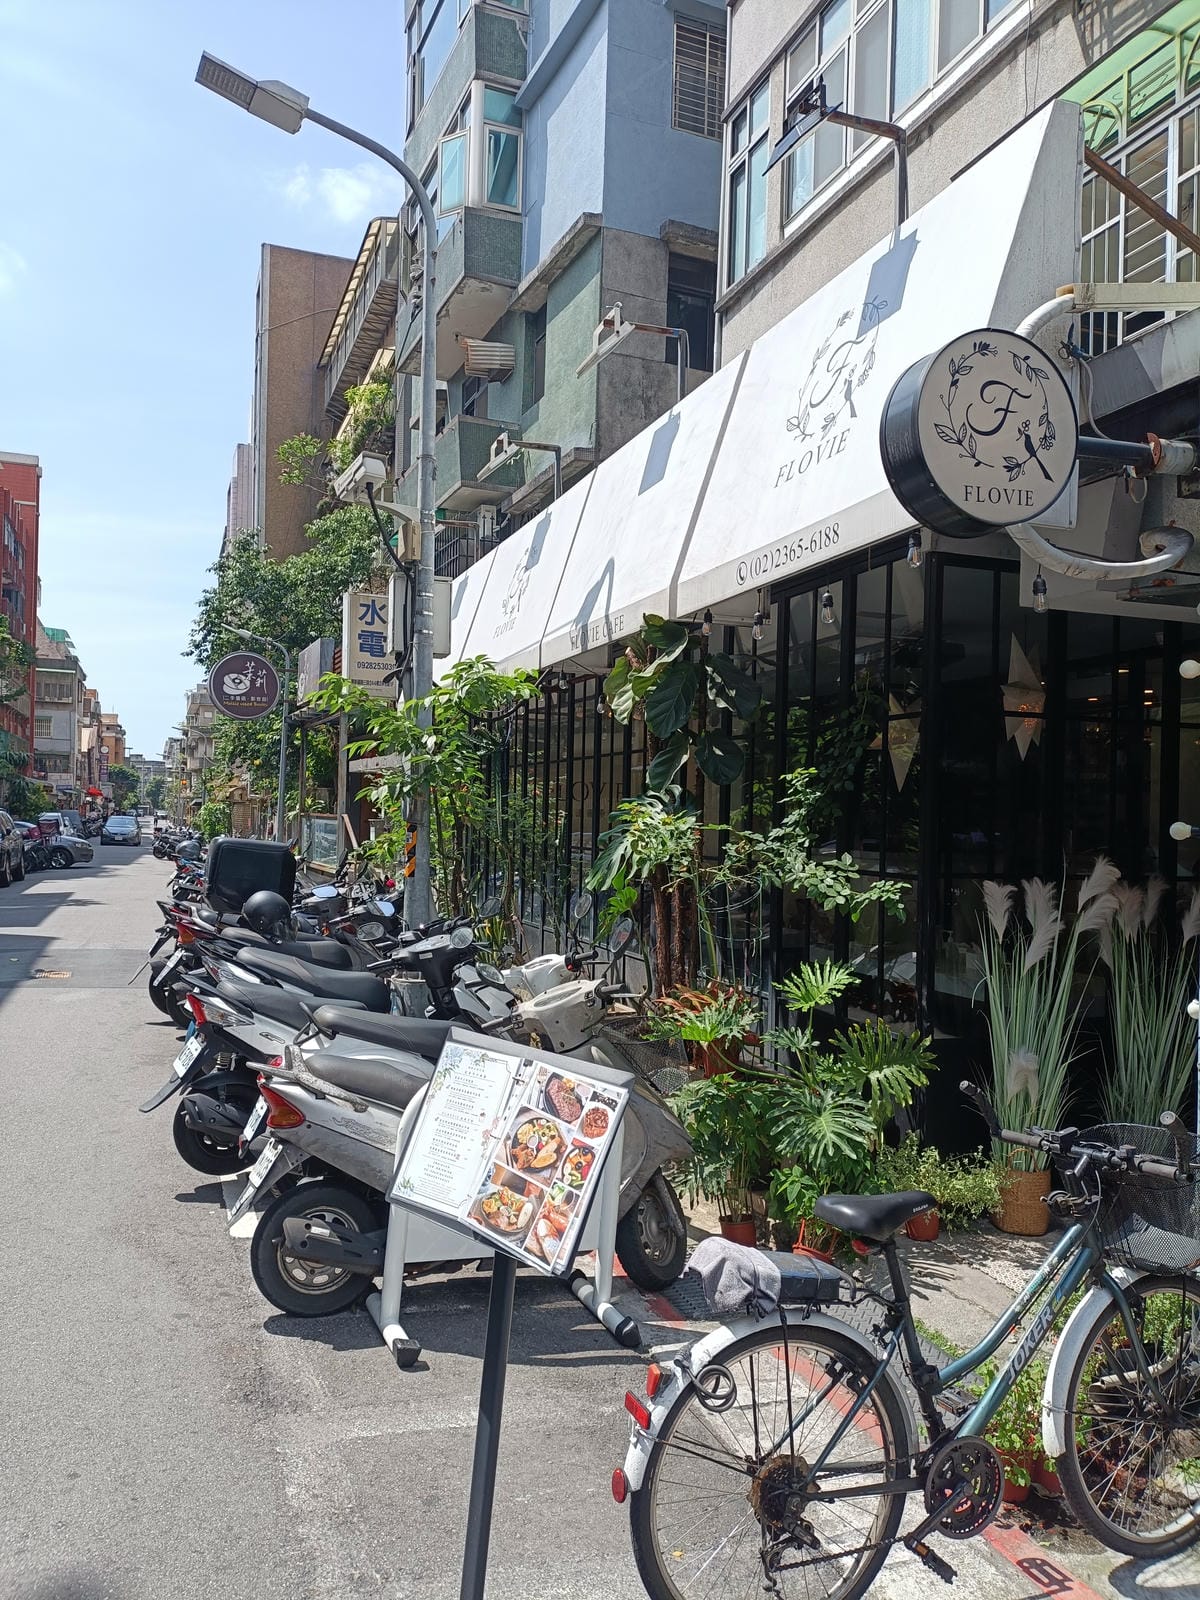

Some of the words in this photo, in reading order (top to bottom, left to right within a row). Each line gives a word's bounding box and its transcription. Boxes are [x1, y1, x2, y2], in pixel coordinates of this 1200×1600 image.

[774, 428, 851, 489] FLOVIE
[963, 483, 1035, 507] FLOVIE
[749, 522, 840, 580] (02)2365-6188
[357, 598, 388, 658] 水電
[602, 614, 625, 639] CAFE
[1008, 1305, 1053, 1386] JOKER
